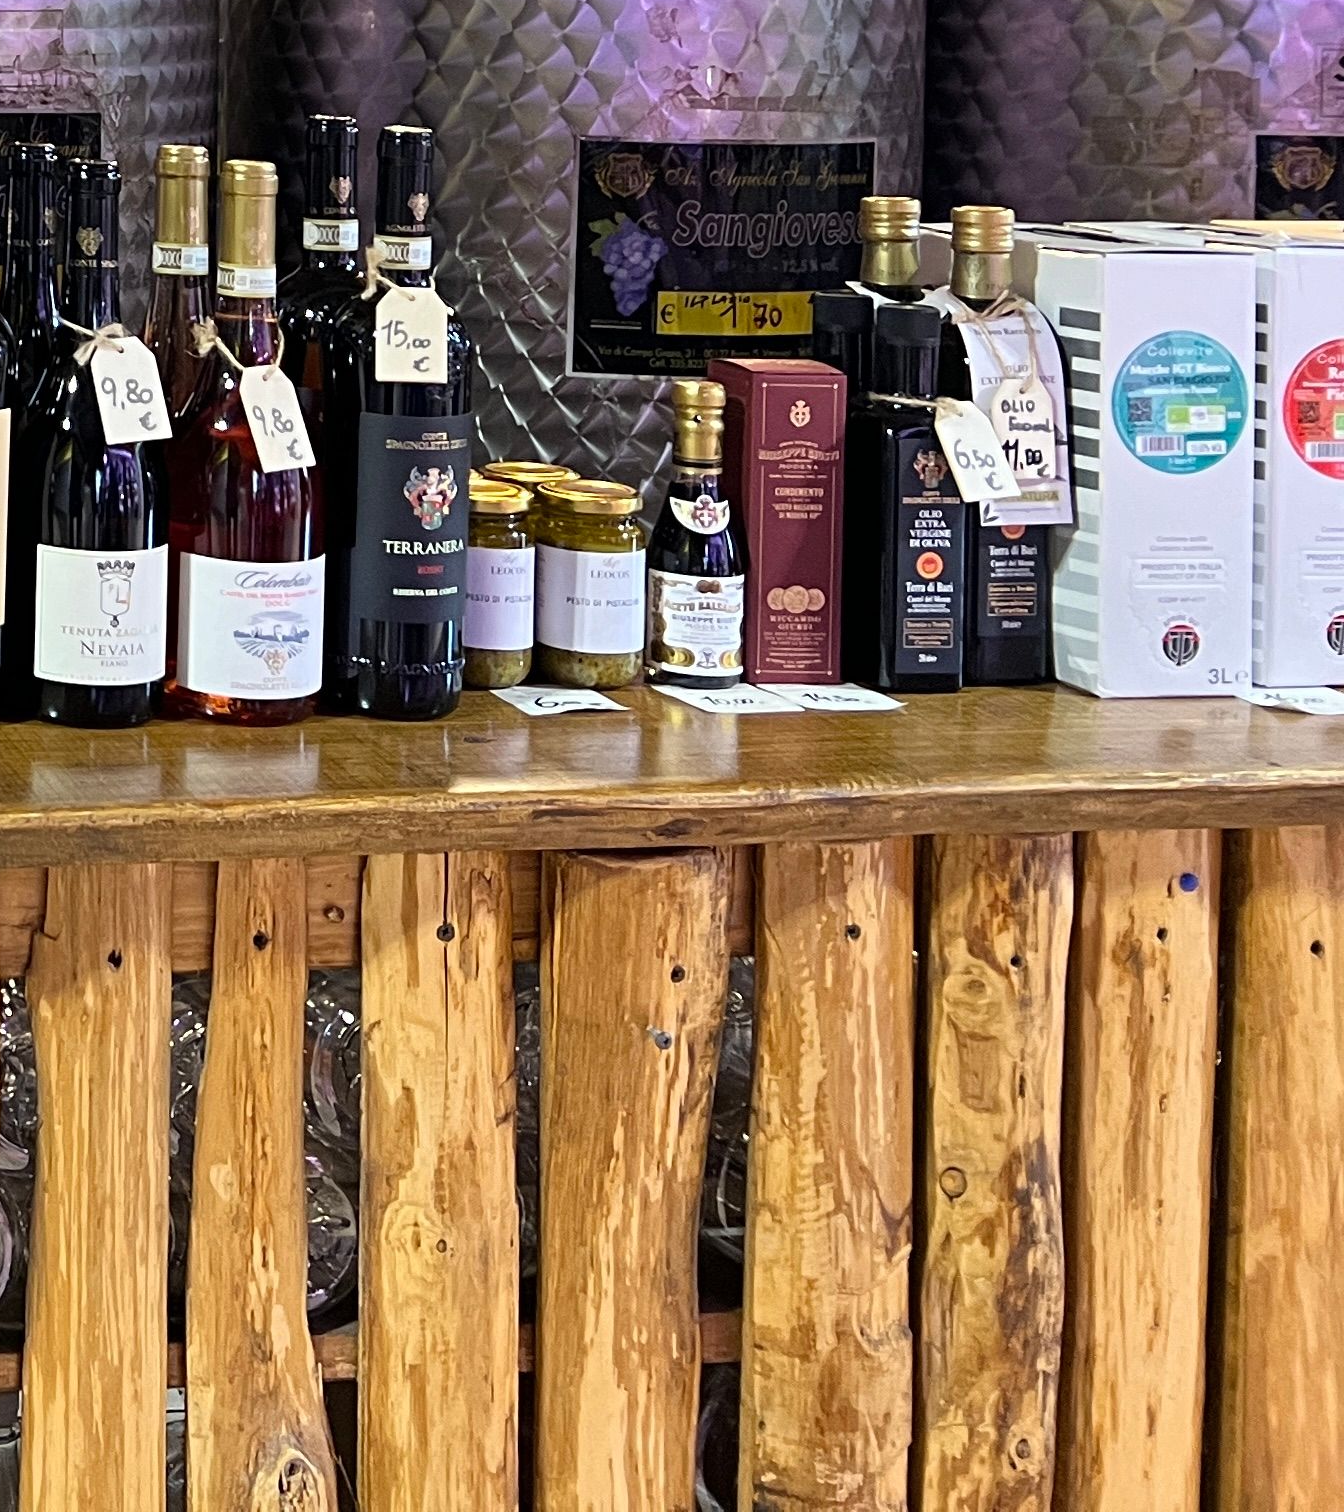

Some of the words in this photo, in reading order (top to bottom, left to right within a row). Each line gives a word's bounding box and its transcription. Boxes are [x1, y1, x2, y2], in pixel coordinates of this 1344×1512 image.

[660, 303, 675, 324] €
[380, 320, 432, 349] 15,00
[413, 355, 430, 373] €
[101, 377, 153, 410] 9,80
[1001, 399, 1035, 413] OLIO
[139, 411, 158, 432] €
[253, 406, 293, 435] 9,80
[286, 438, 303, 460] €
[954, 439, 995, 469] 6,50
[985, 472, 1003, 490] €
[919, 510, 943, 519] OLIO
[914, 519, 947, 529] EXTRA
[909, 529, 952, 539] VERGINE
[909, 538, 920, 548] DI
[921, 538, 951, 548] OLIVA
[382, 538, 464, 556] TERRANERA
[61, 625, 112, 637] TENUTA
[80, 640, 145, 657] NEVAIA
[100, 659, 129, 668] FIANO
